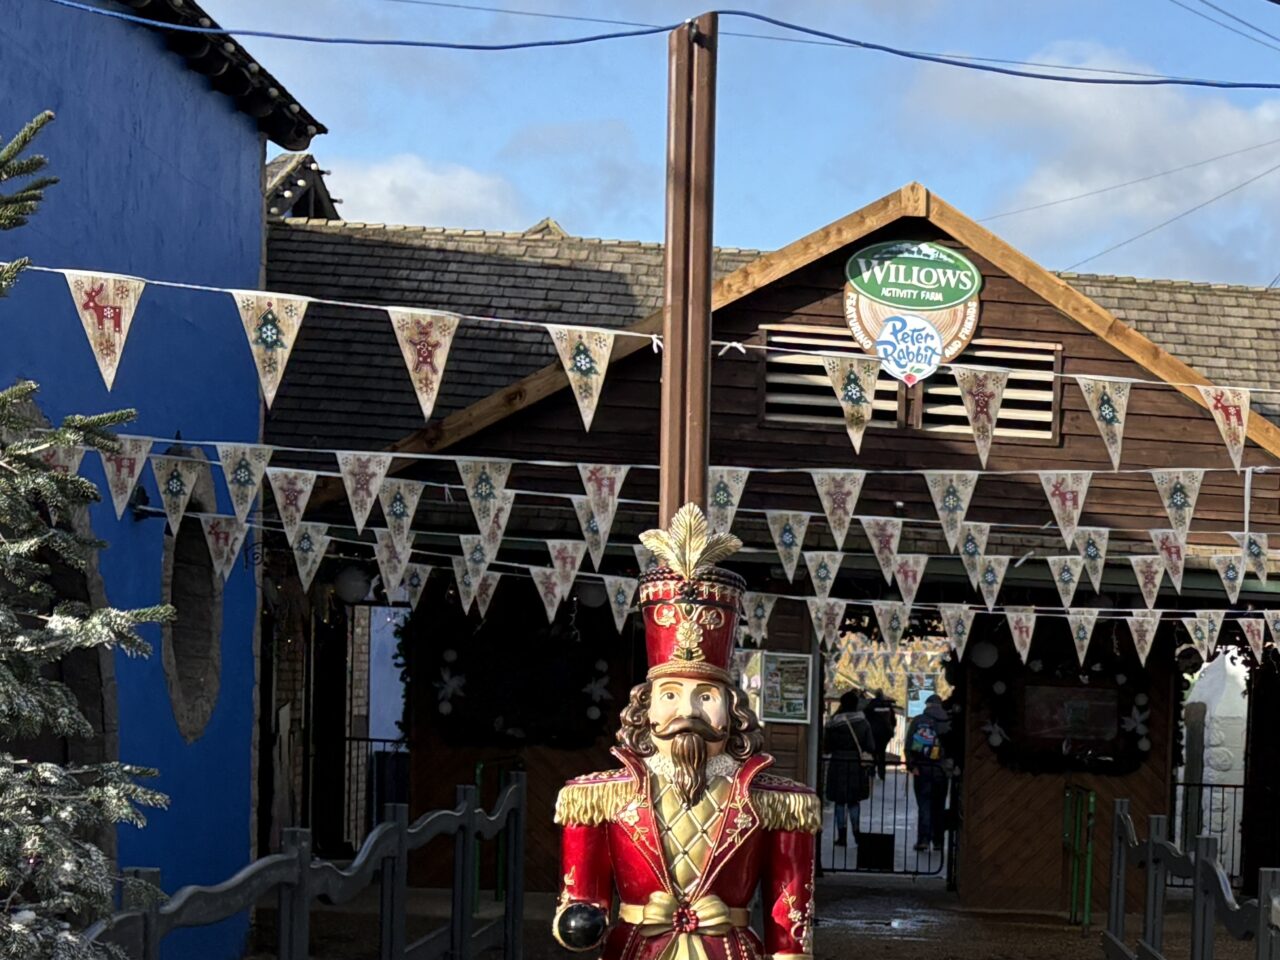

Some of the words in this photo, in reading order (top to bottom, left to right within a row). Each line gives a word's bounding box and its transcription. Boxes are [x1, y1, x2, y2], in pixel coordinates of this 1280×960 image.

[857, 257, 972, 290] WILLOWS
[881, 287, 919, 299] ACTIVITY
[921, 290, 944, 302] FARM
[845, 292, 873, 350] FEATURING
[882, 316, 935, 345] Peter
[944, 339, 961, 358] AND
[958, 301, 978, 339] FRIENDS
[875, 340, 943, 369] Rabbit
